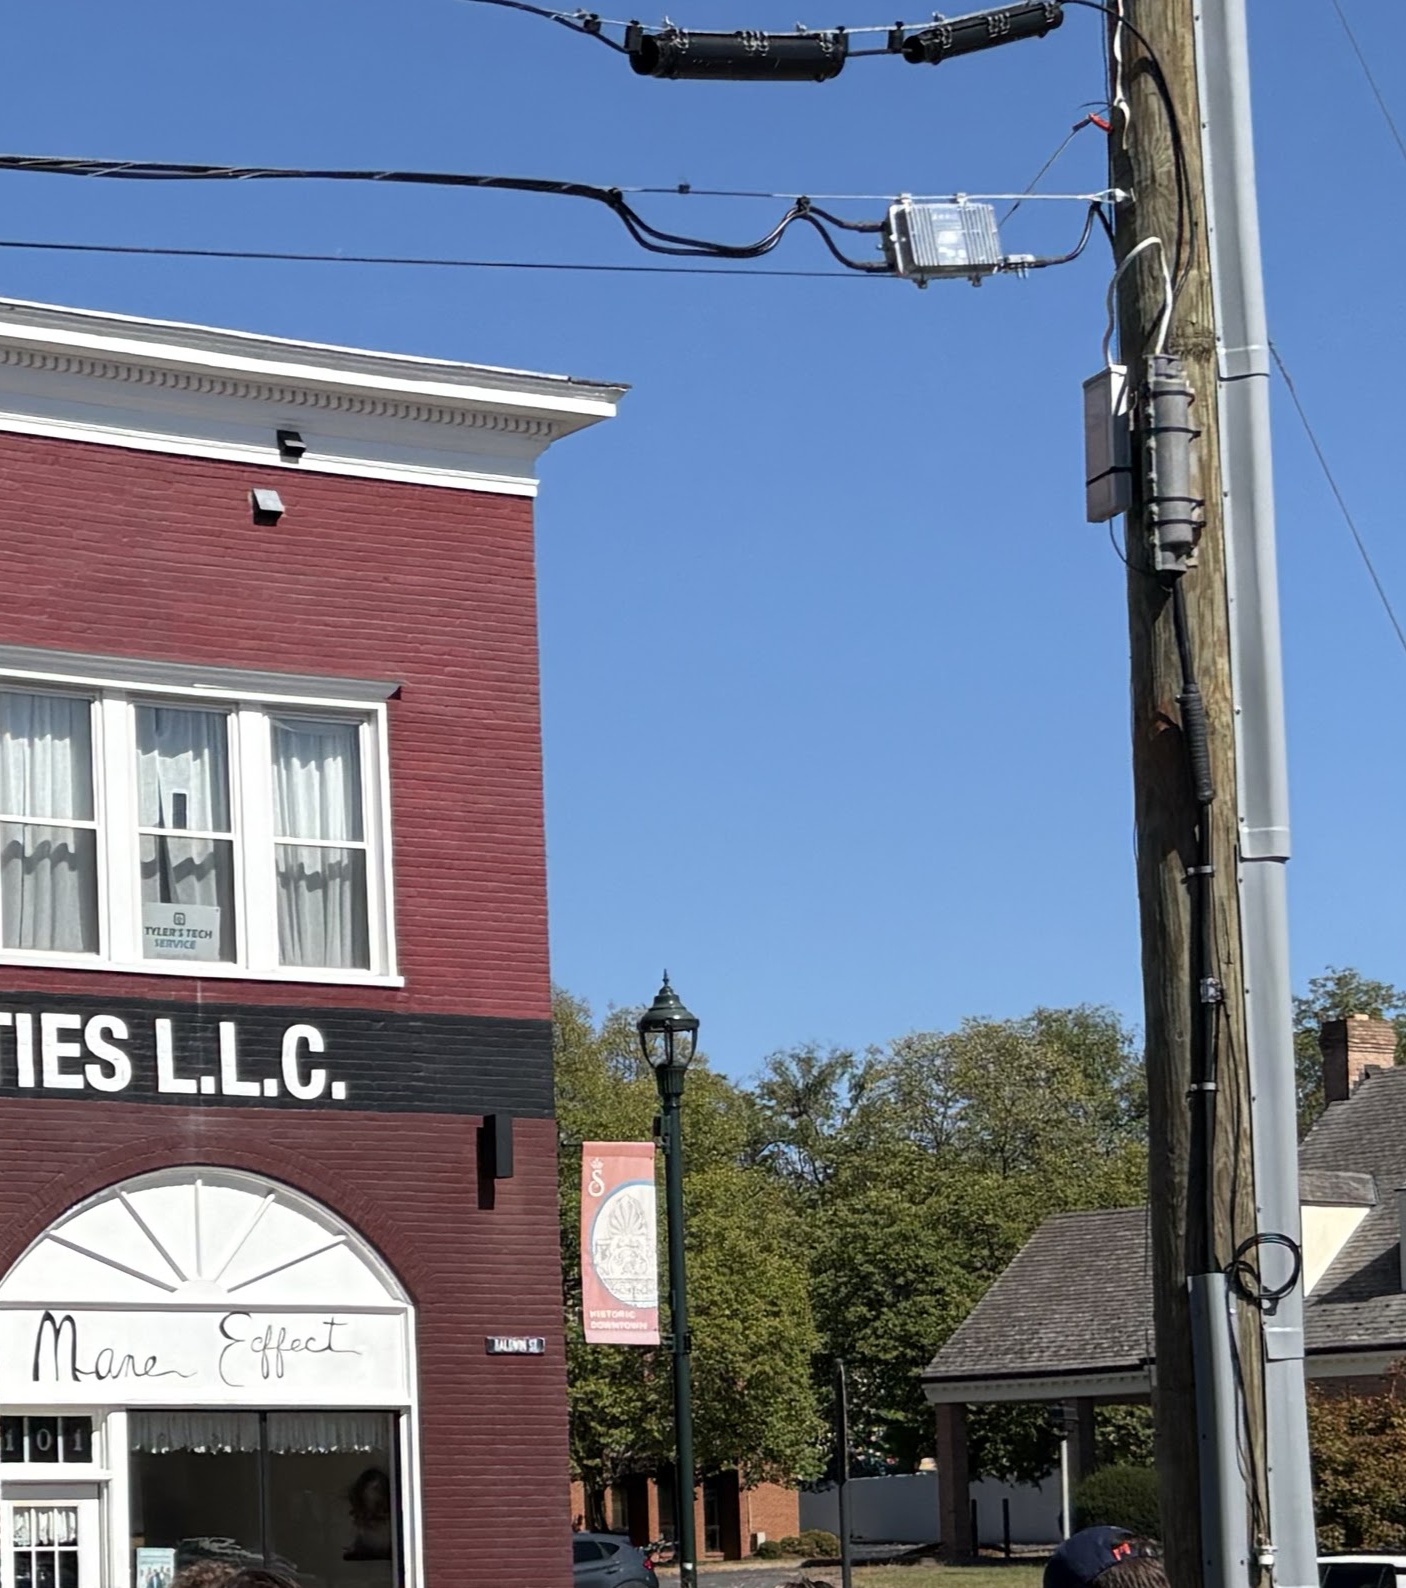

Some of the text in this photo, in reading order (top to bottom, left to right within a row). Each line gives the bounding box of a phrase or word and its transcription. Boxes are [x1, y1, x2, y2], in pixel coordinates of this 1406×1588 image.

[144, 926, 213, 939] TYLER'S TECH
[154, 938, 197, 950] SERVICE
[155, 1018, 346, 1100] L.L.C.
[589, 1309, 637, 1319] HISTORIC
[590, 1320, 648, 1330] DOWNTOWN
